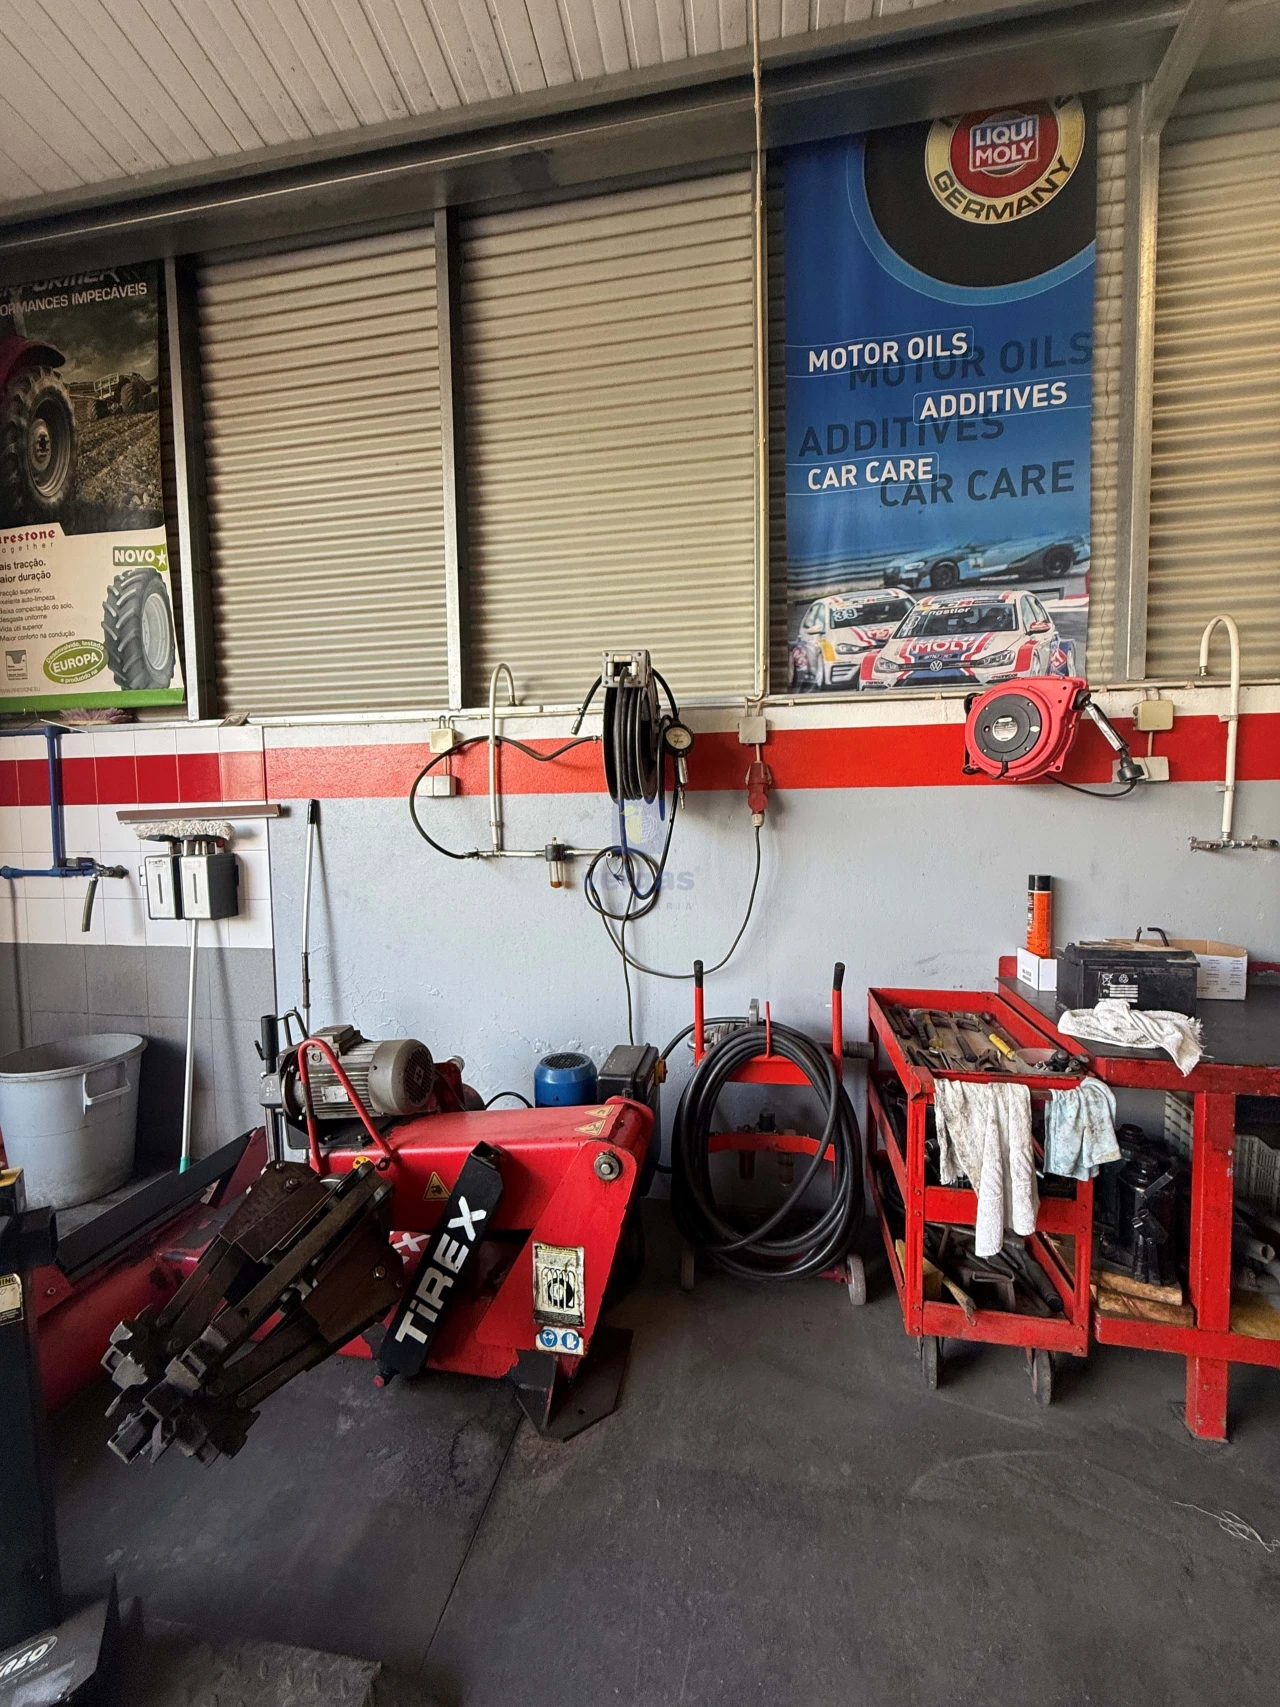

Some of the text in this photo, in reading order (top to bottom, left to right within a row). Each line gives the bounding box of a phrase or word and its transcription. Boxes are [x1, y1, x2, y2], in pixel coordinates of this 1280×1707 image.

[975, 120, 1034, 147] LIQUI
[975, 140, 1034, 167] MOLY
[934, 155, 1071, 220] GERMANY
[0, 282, 148, 316] ORMANCES IMPECÁVEIS
[808, 332, 969, 373] MOTOR OILS
[1000, 331, 1093, 371] OILS
[919, 381, 1067, 420] ADDITIVES
[799, 408, 1004, 457] ADDITIVES
[807, 458, 933, 491] CAR CARE
[880, 459, 1075, 507] CAR CARE
[1, 542, 54, 555] ogether
[114, 549, 156, 563] NOVO
[0, 561, 12, 571] ais
[0, 570, 52, 584] aior duração
[913, 639, 976, 654] MOLY
[52, 652, 99, 673] EUROPA
